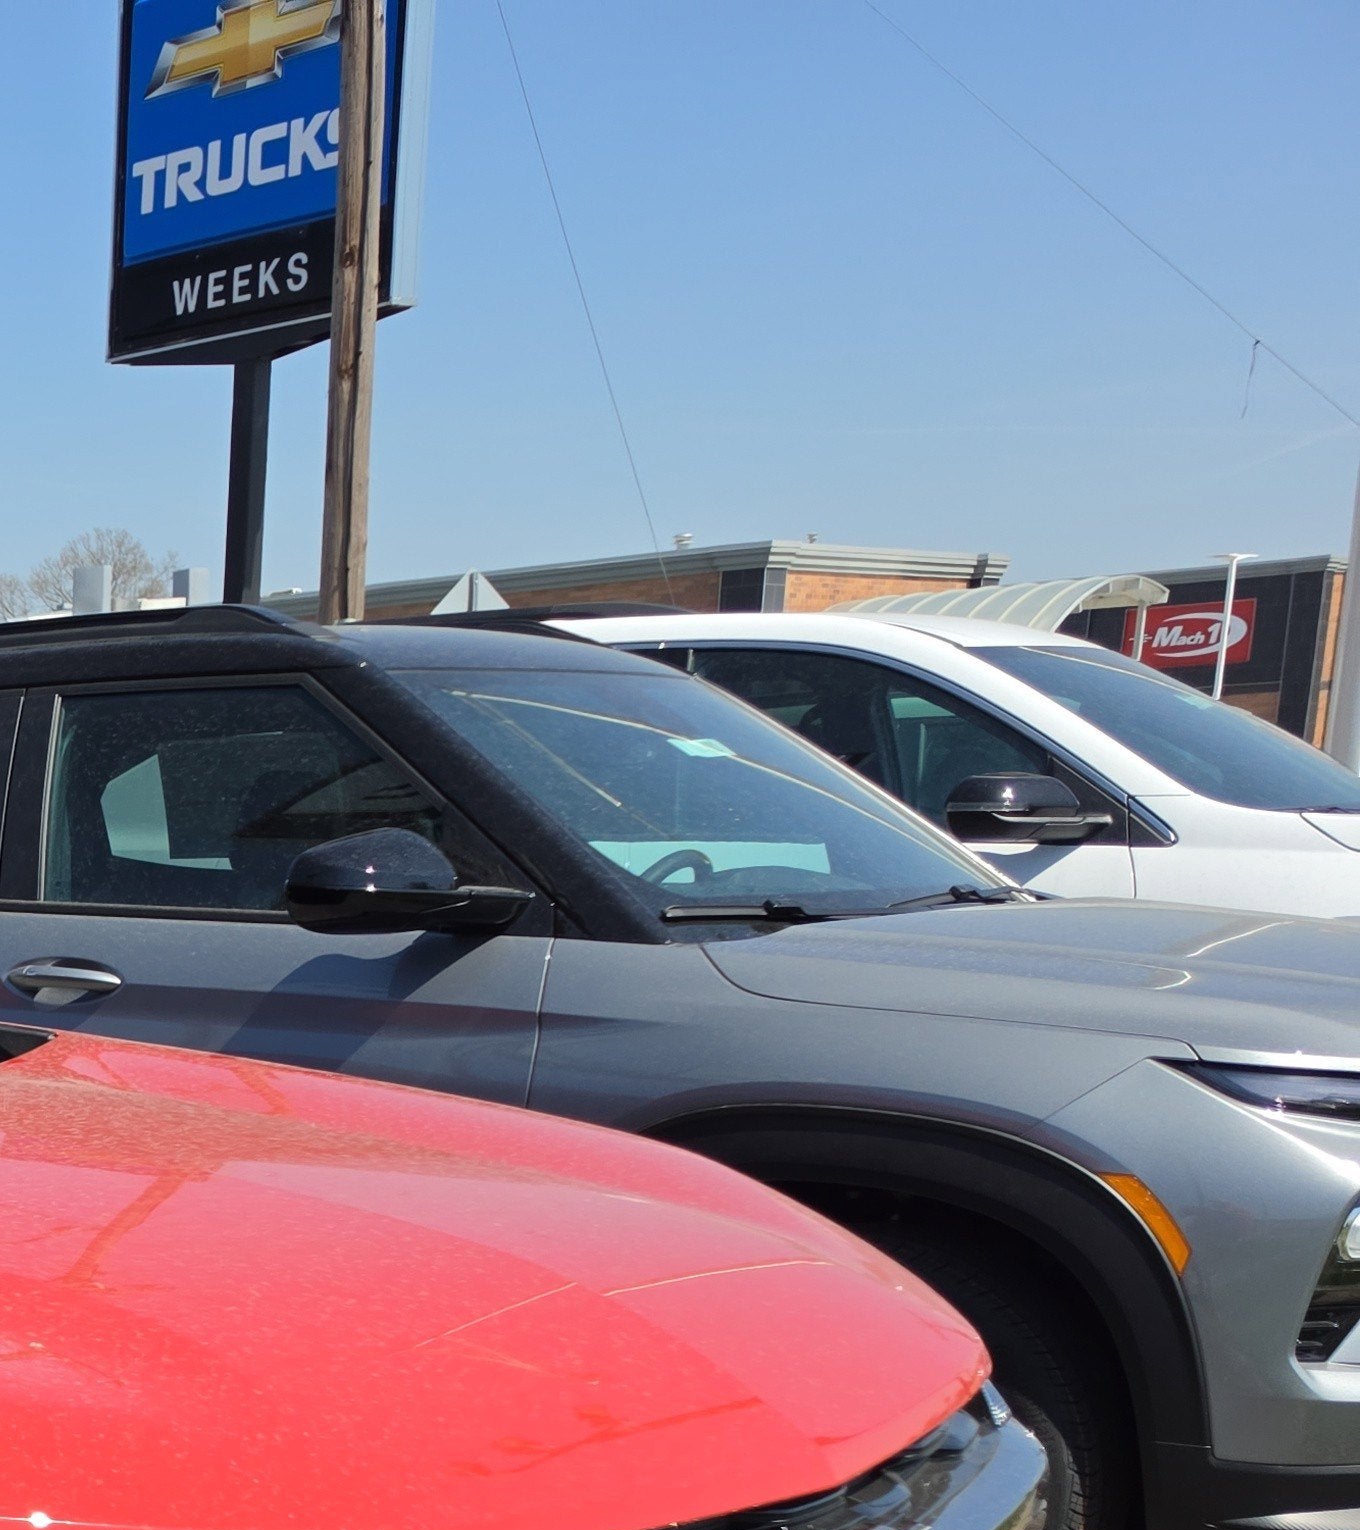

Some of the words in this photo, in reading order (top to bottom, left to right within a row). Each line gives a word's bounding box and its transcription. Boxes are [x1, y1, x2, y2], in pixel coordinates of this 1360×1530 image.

[173, 251, 309, 316] WEEKS
[1151, 625, 1205, 648] Mach
[1207, 622, 1231, 645] 1
